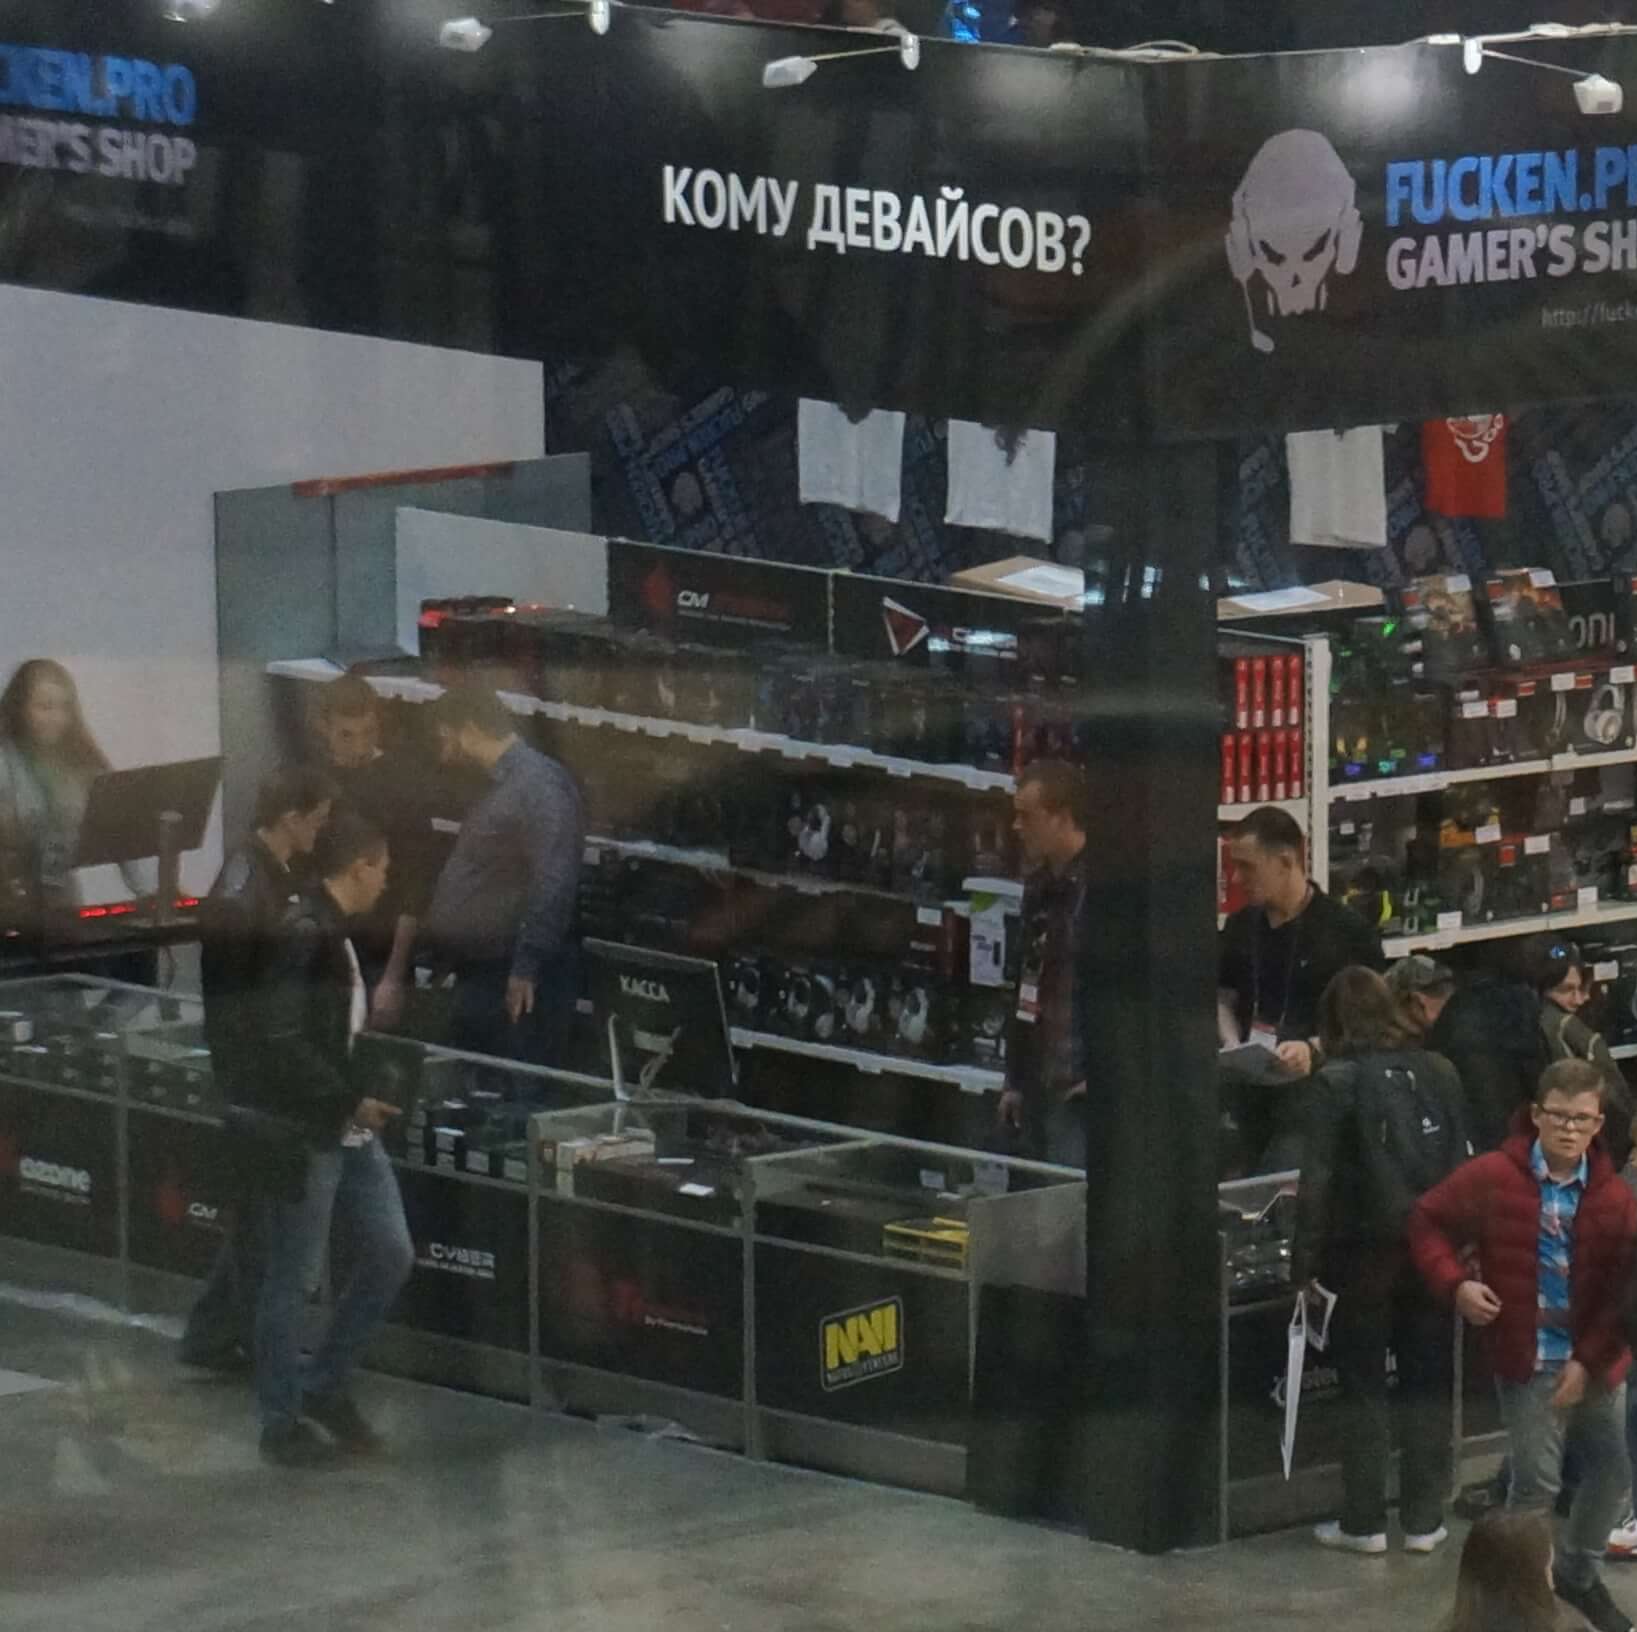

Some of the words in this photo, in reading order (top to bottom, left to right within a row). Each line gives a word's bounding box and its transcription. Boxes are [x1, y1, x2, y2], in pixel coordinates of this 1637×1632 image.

[99, 128, 197, 184] SHOP
[662, 164, 799, 237] КОМУ
[806, 185, 1091, 276] ДЕВАЙСОВ?
[1386, 223, 1575, 291] GAMER'S
